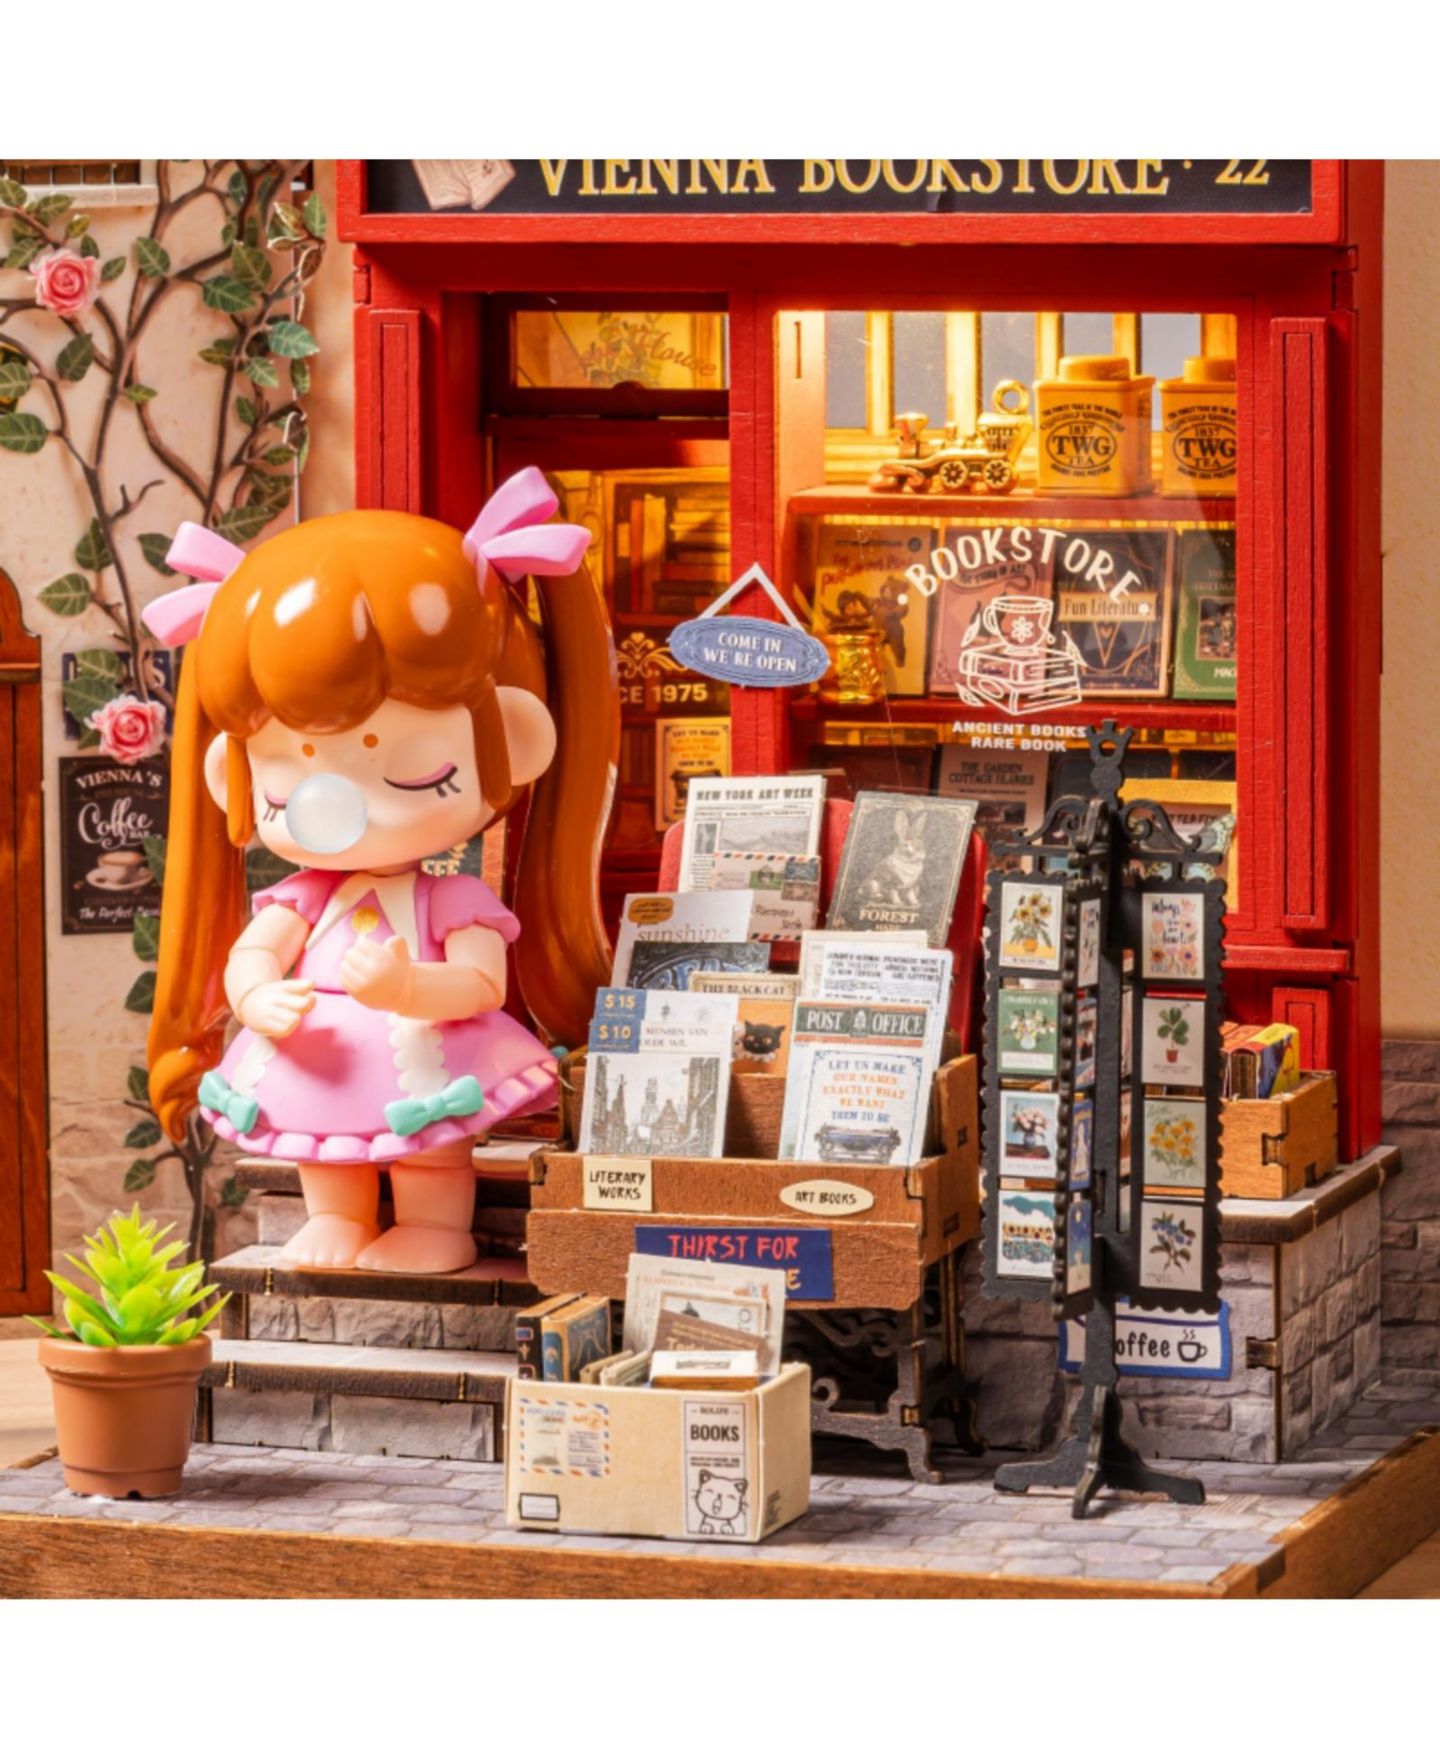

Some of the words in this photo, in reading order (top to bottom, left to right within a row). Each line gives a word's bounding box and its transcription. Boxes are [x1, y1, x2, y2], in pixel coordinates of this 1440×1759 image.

[538, 159, 776, 196] VIENNA
[798, 159, 1170, 195] BOOKSTORE
[1214, 159, 1271, 185] 22
[1052, 435, 1111, 456] TWG
[1179, 437, 1237, 458] TWG
[1193, 457, 1222, 467] TEA
[905, 525, 1142, 605] BOOKSTORE
[1091, 597, 1153, 616] Literatu
[718, 632, 760, 651] COME
[765, 637, 782, 653] IN
[757, 657, 797, 673] OPEN
[651, 683, 708, 703] 1975
[952, 721, 1025, 736] ANCIENT
[1030, 724, 1088, 738] BOOKS
[971, 736, 1015, 749] RARE
[1020, 738, 1067, 752] BOOK
[78, 797, 154, 851] Coffee
[859, 909, 919, 924] FOREST
[806, 1010, 843, 1030] POST
[872, 1012, 923, 1035] OFFICE
[828, 1060, 849, 1071] LET
[855, 1061, 869, 1070] US
[873, 1062, 906, 1074] MAKE
[832, 1110, 857, 1120] THEM
[589, 1170, 646, 1186] LITERARY
[598, 1185, 641, 1200] WORKS
[795, 1190, 816, 1203] ART
[819, 1191, 857, 1205] BOOKS
[668, 1234, 749, 1260] THIRST
[757, 1236, 800, 1261] FOR
[786, 1267, 801, 1290] E
[1115, 1331, 1171, 1358] offee
[690, 1424, 740, 1442] BOOKS
